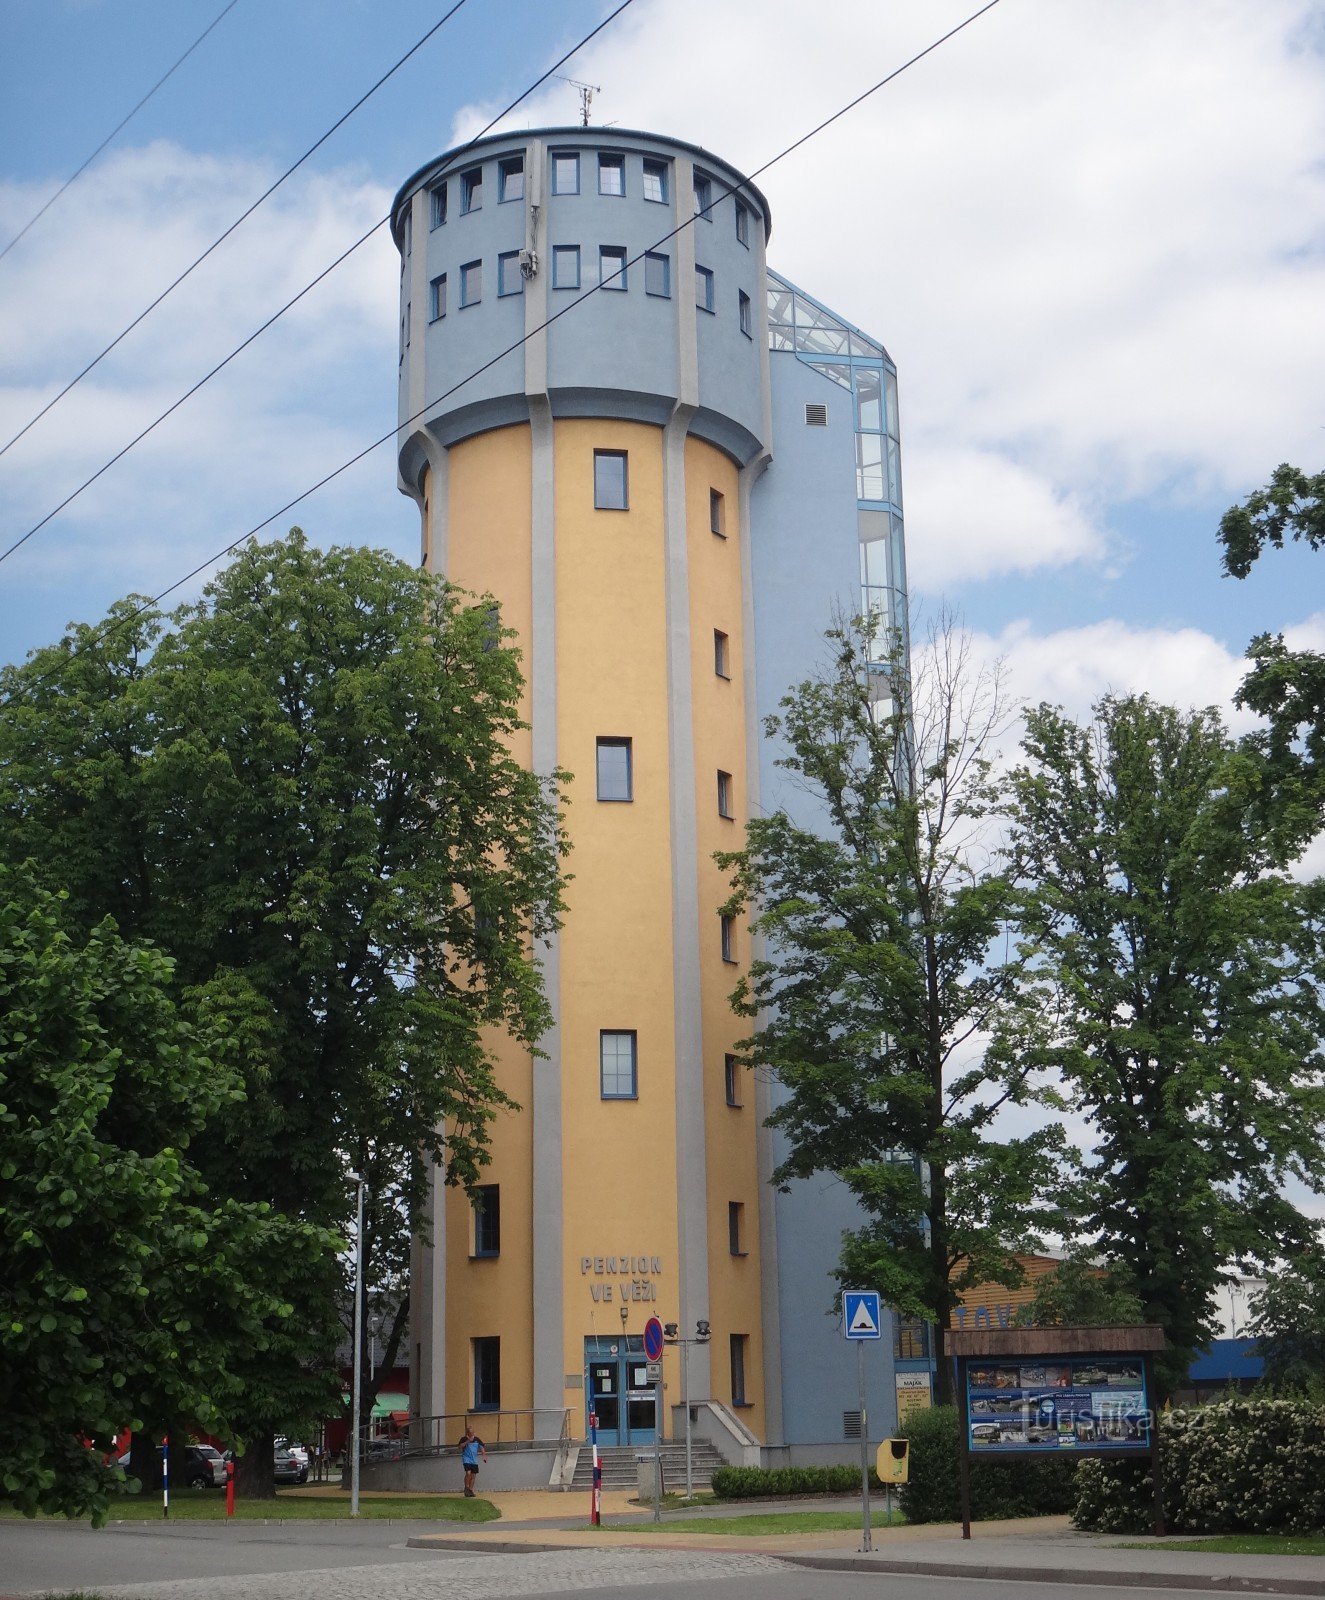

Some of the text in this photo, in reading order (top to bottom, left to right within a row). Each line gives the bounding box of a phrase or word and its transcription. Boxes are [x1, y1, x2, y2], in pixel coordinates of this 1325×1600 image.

[582, 1256, 661, 1274] PENZION
[590, 1279, 656, 1302] VE VĚŽI
